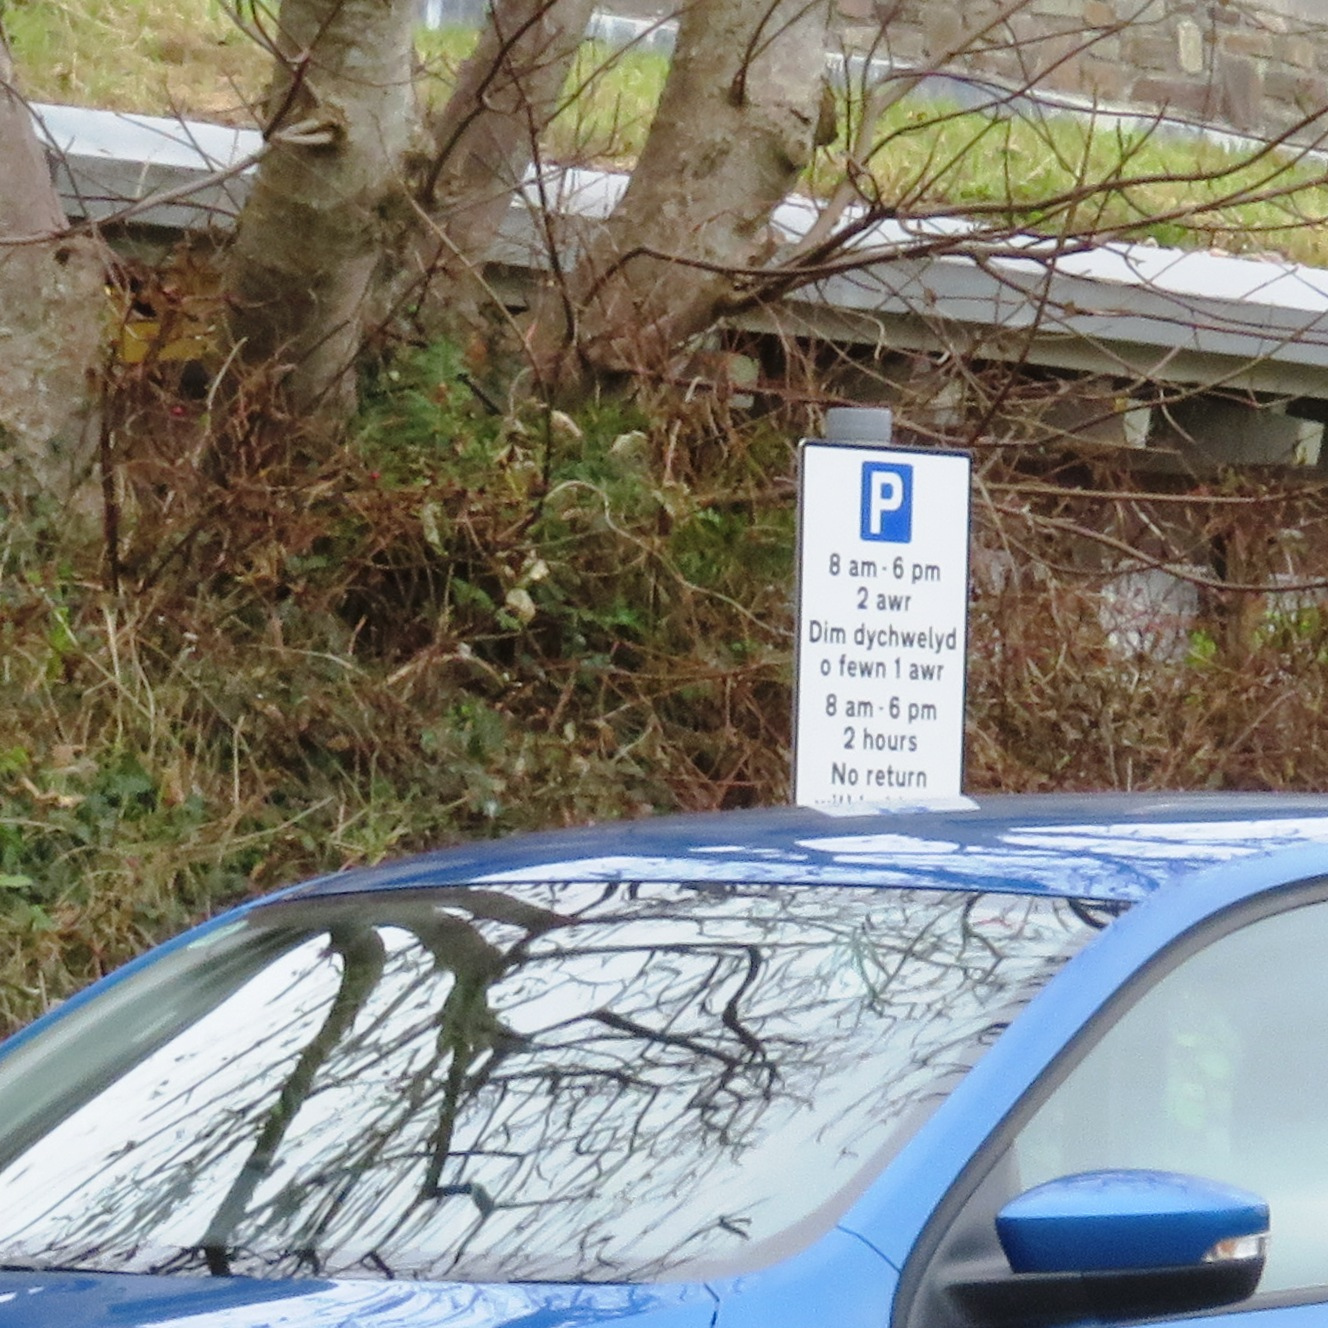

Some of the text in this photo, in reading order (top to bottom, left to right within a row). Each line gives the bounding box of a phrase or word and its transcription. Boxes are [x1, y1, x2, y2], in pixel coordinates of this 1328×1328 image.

[869, 470, 904, 535] P
[828, 552, 841, 577] 8
[848, 559, 878, 578] am
[892, 555, 905, 580] 6
[911, 563, 941, 585] pm
[857, 585, 912, 612] 2 awr
[808, 619, 957, 655] Dim dychwelyd
[820, 653, 944, 681] o fewn 1 awr
[825, 693, 838, 717] 8
[845, 700, 874, 718] am
[888, 695, 901, 720] 6
[908, 702, 937, 725] pm
[843, 725, 918, 752] 2 hours
[831, 762, 927, 789] No return
